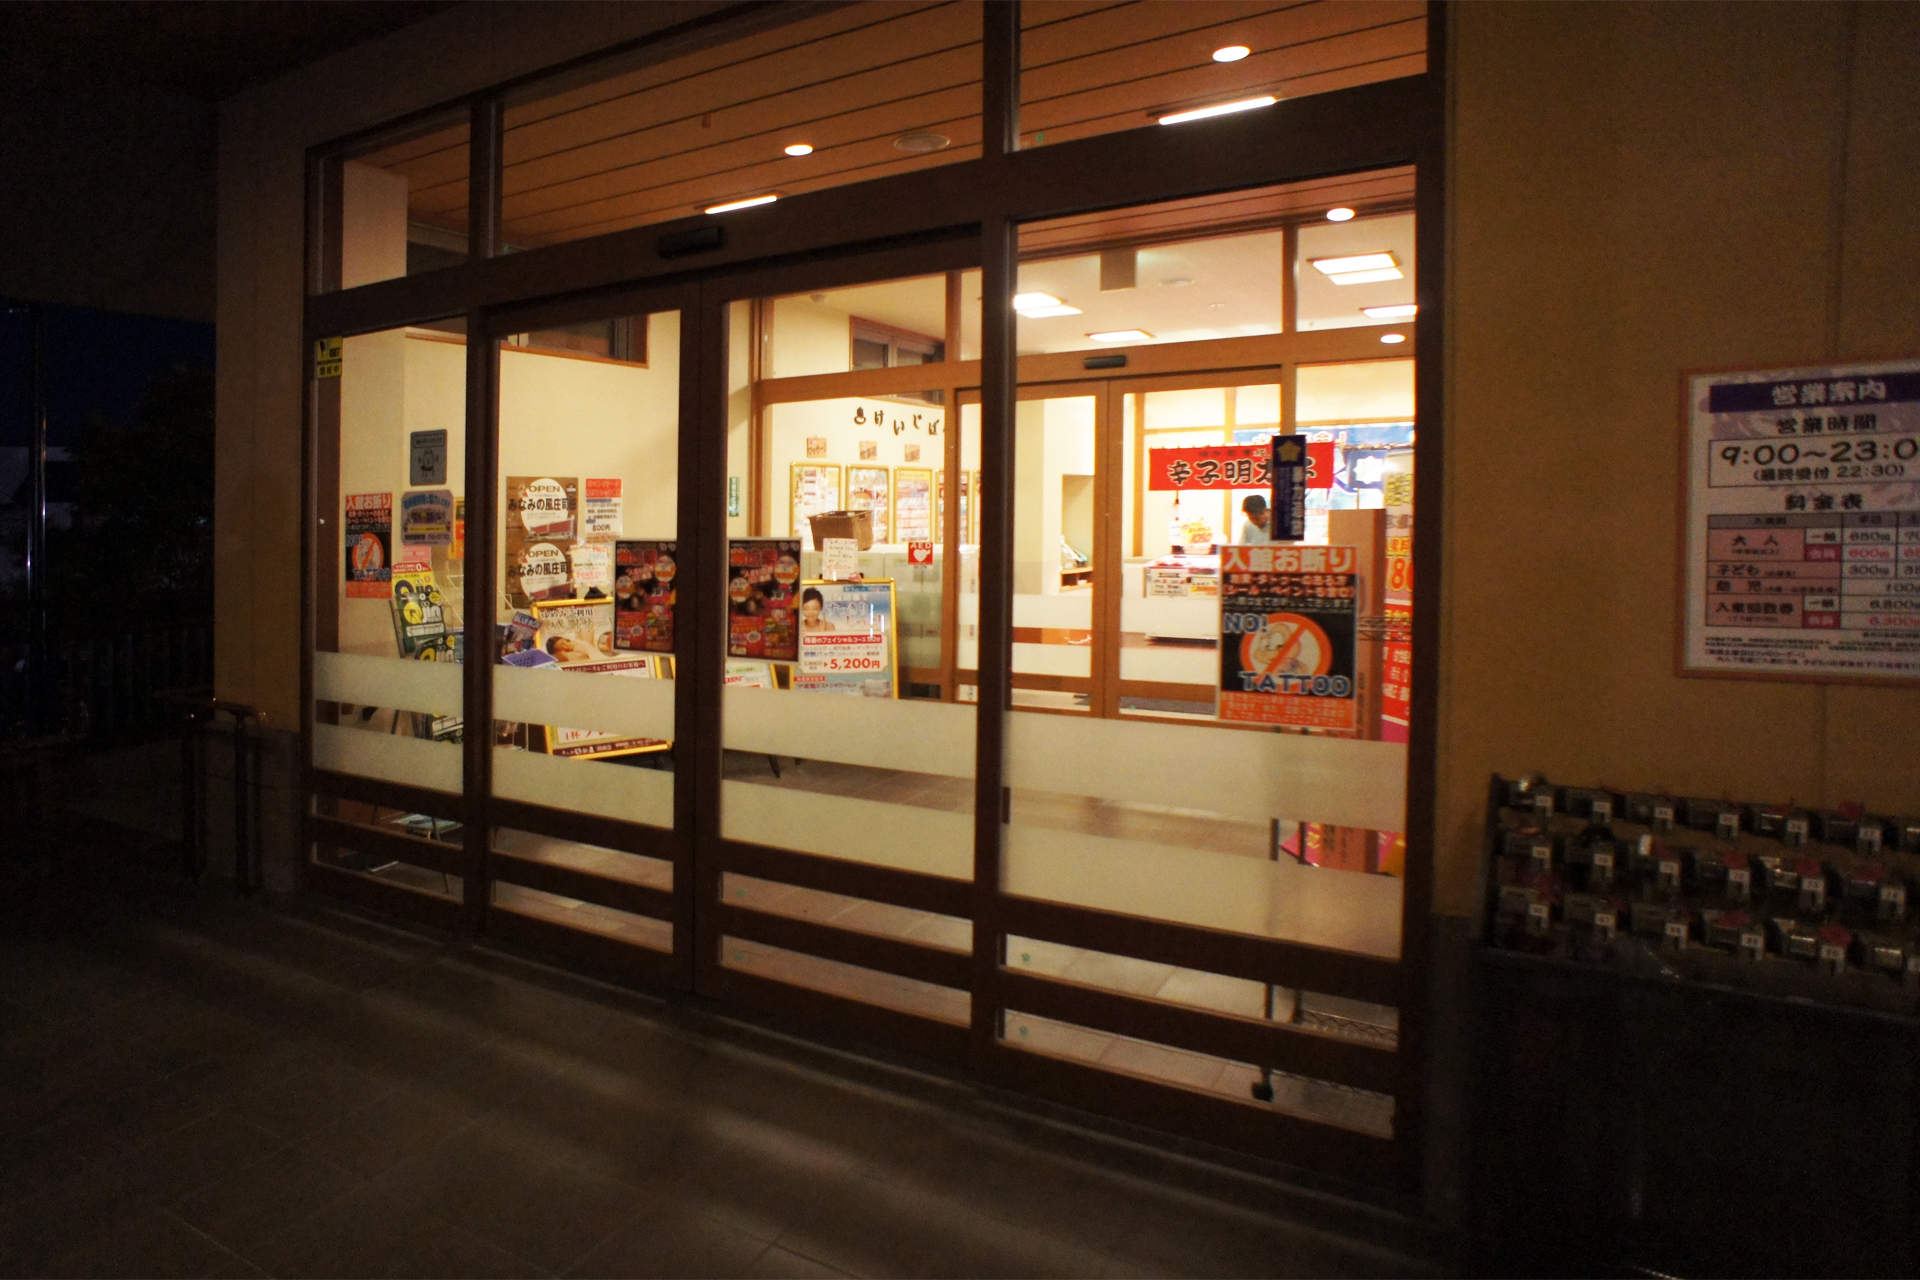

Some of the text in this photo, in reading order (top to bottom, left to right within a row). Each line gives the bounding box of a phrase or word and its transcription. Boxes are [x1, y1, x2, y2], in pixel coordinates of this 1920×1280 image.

[1772, 379, 1887, 405] 営業案内
[874, 409, 945, 437] けいじば
[1777, 414, 1877, 435] 営業時間
[529, 485, 561, 494] OPEN
[1784, 493, 1863, 511] 料金表
[529, 550, 560, 559] OPEN
[1223, 547, 1353, 573] 入館お断り
[353, 567, 391, 581] TATTOO
[1222, 612, 1268, 634] NO!
[830, 658, 881, 671] 5,200円
[1237, 671, 1352, 698] TATTOO
